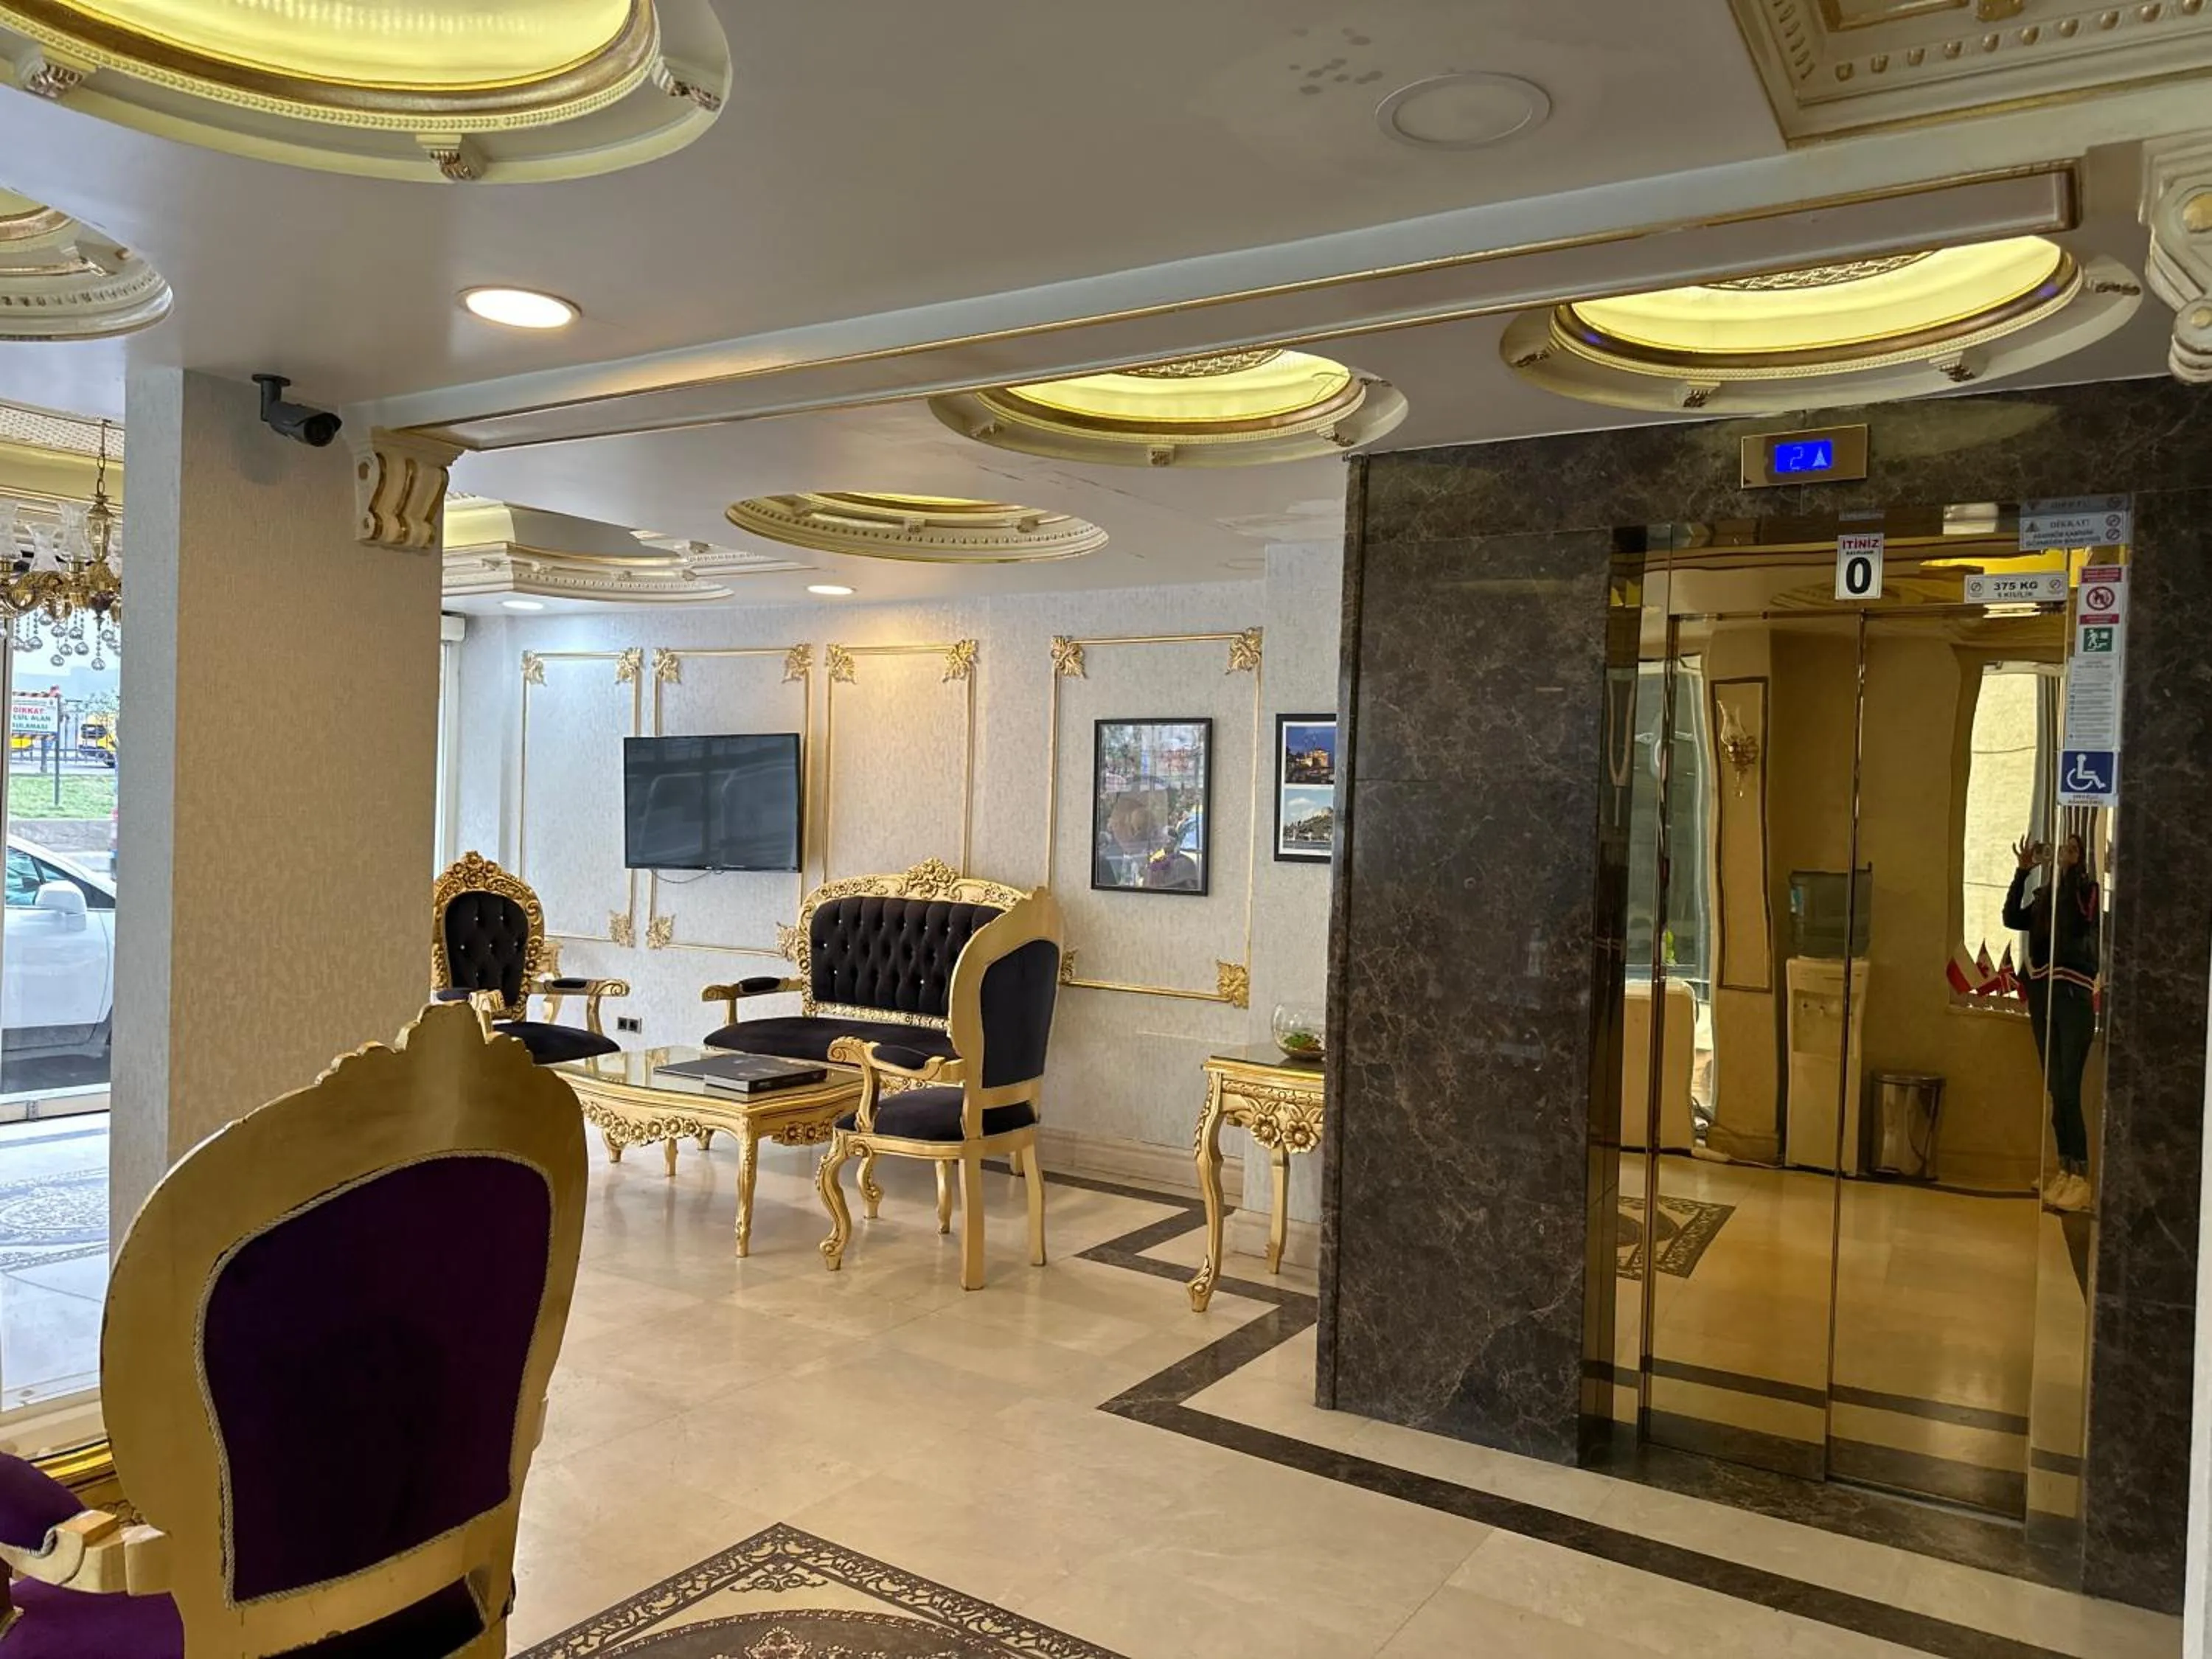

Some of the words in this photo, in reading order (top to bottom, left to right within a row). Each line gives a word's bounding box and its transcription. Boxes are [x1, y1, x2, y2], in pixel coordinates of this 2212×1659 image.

[1790, 446, 1804, 470] 2
[1846, 557, 1872, 594] 0
[1993, 582, 2017, 591] 375
[2020, 580, 2039, 590] KG
